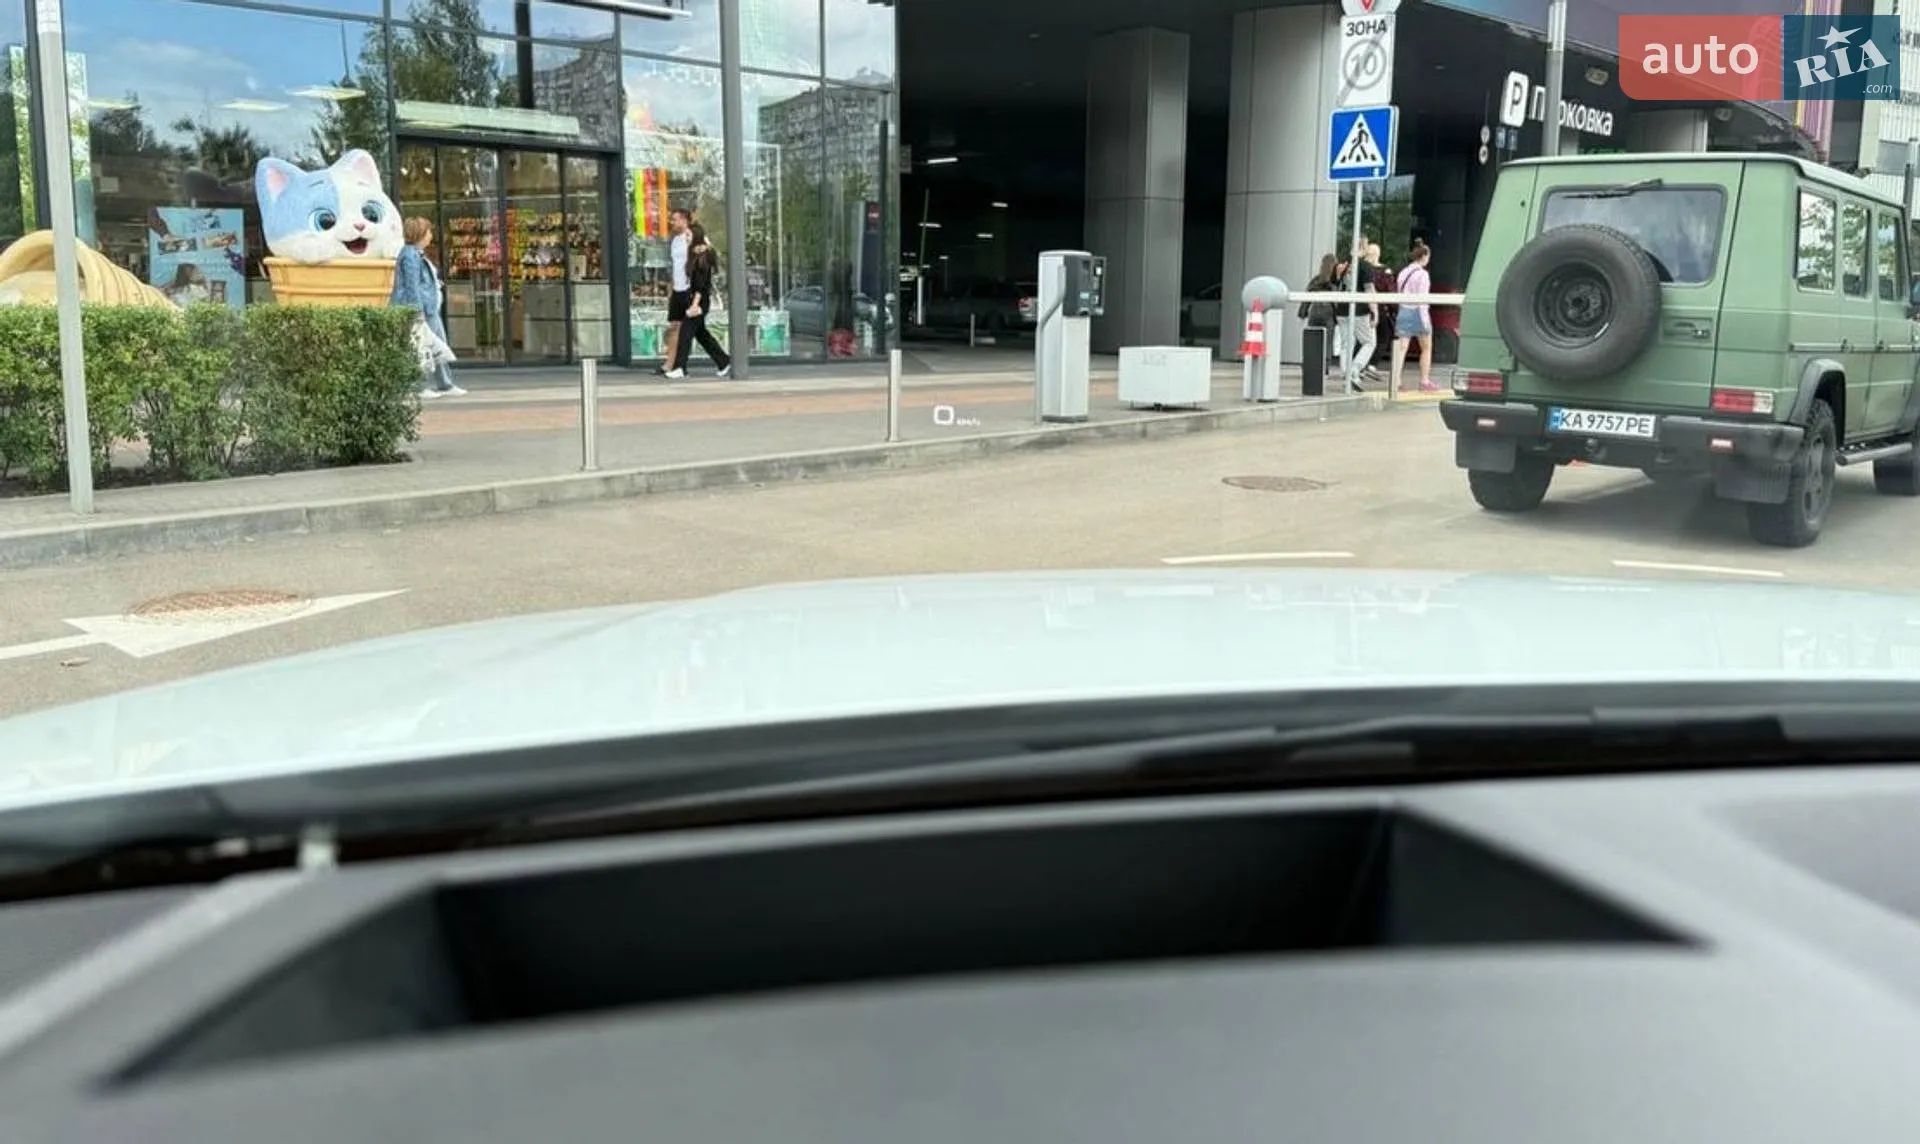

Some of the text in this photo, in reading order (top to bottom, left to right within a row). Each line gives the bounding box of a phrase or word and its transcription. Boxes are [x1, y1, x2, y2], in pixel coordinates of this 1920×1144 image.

[1346, 19, 1387, 37] ЗОНА
[1351, 51, 1377, 77] 10
[1560, 411, 1651, 435] KA 9757 PE
